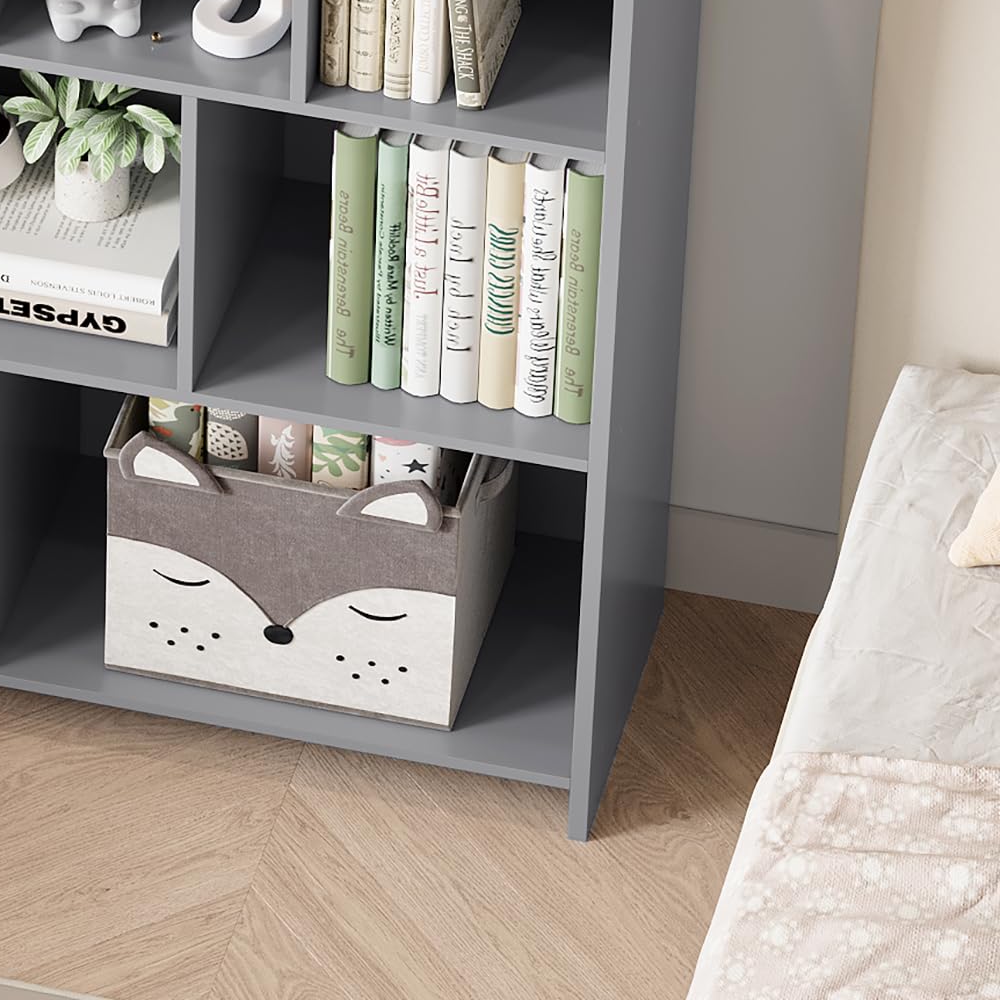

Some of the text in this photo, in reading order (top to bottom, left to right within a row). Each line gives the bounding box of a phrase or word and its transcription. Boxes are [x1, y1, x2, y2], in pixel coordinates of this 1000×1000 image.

[454, 24, 473, 45] THE
[456, 46, 475, 81] SHACK
[29, 279, 87, 295] STEVENSON
[119, 293, 156, 306] ROBERT
